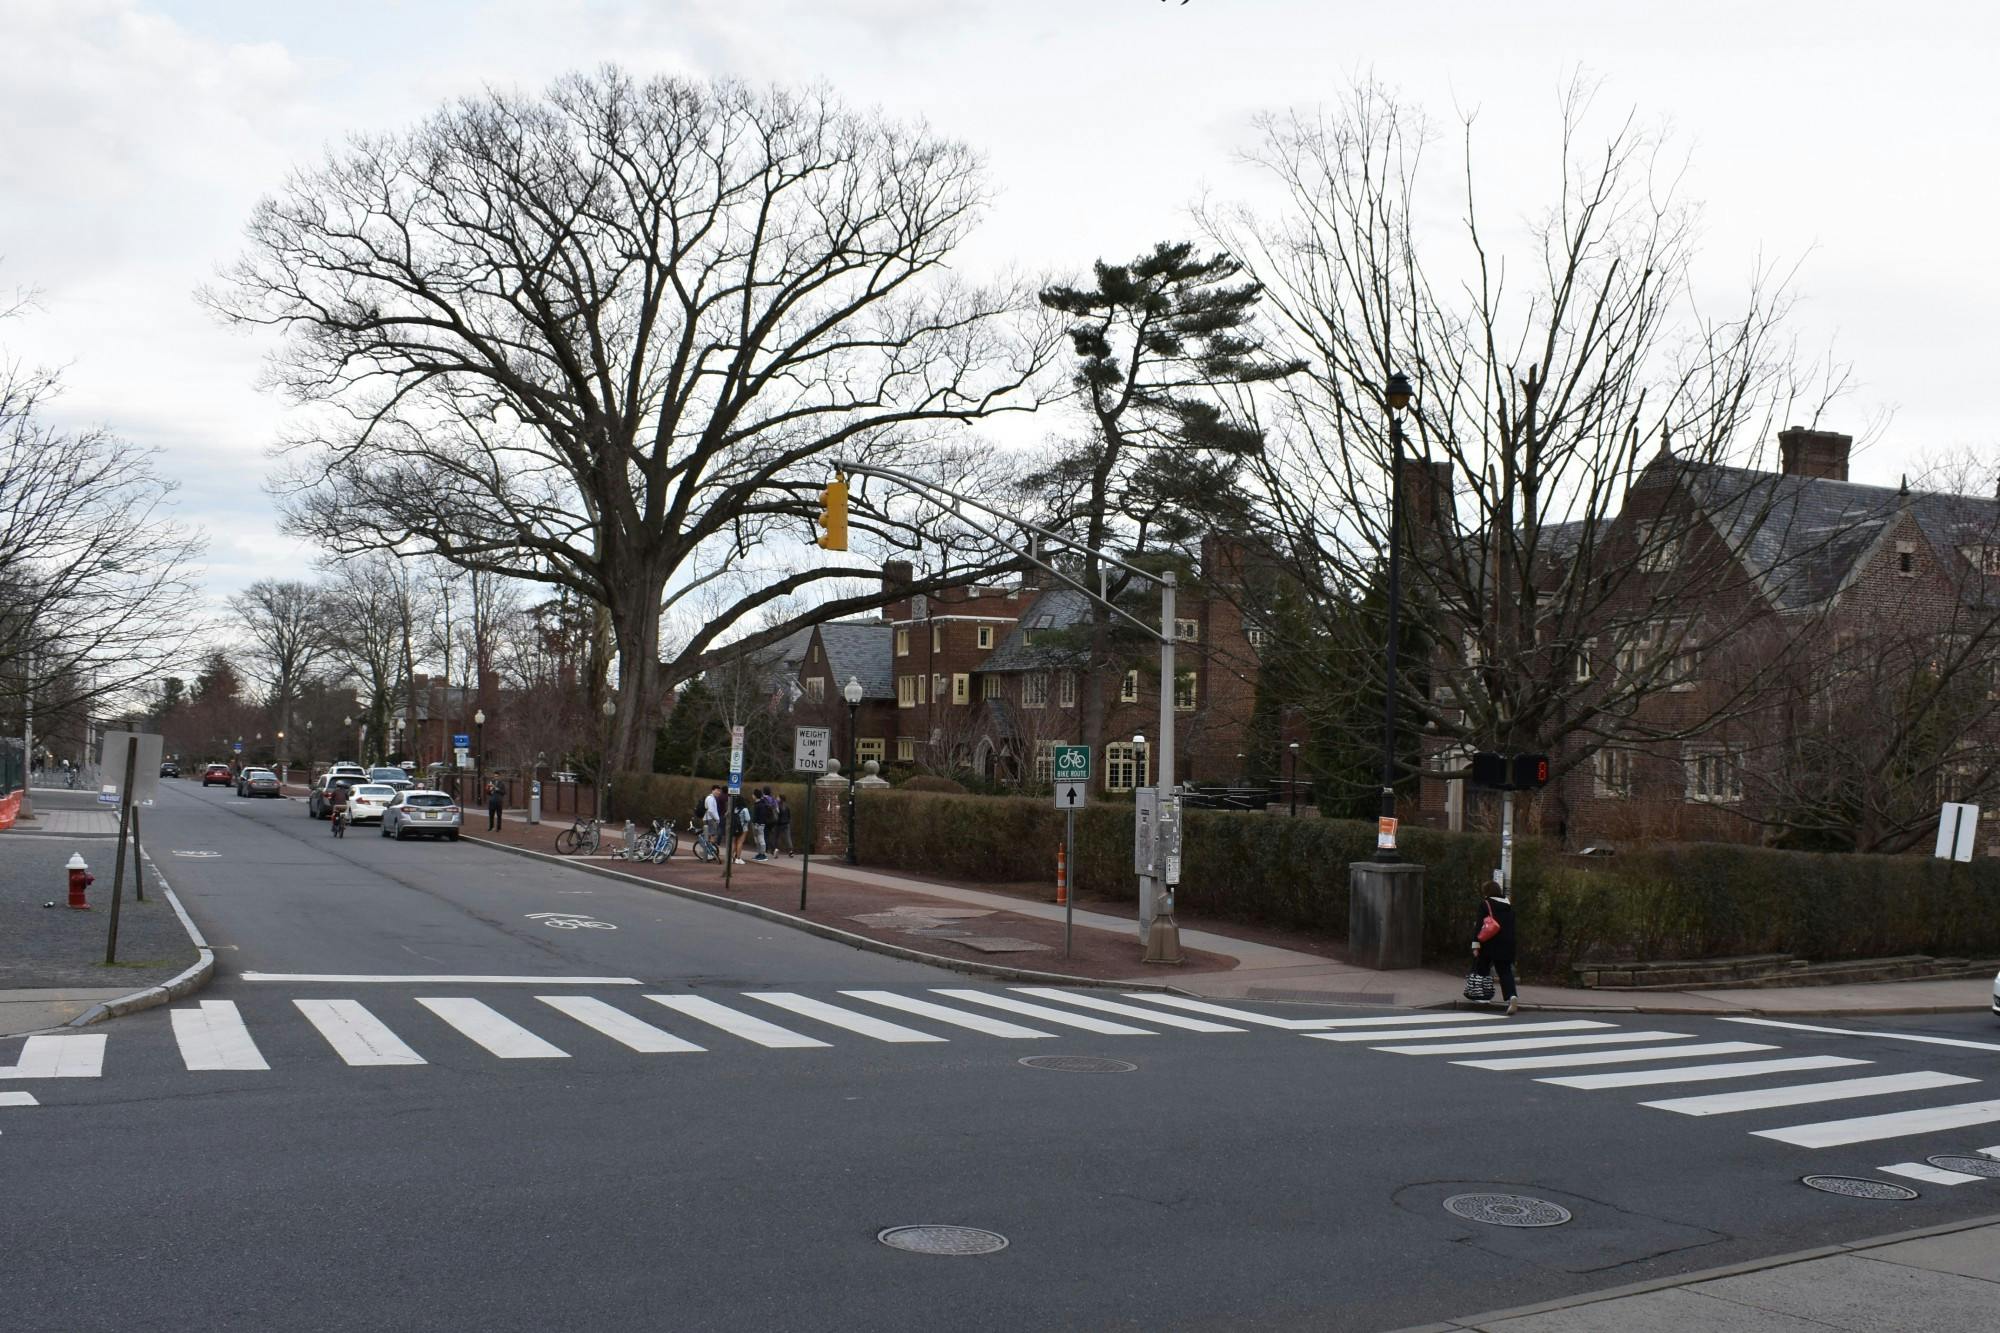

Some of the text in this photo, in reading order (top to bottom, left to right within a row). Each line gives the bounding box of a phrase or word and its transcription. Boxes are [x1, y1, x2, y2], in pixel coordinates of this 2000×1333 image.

[800, 730, 827, 738] WEIGHT
[808, 749, 815, 757] 4
[800, 759, 824, 768] TONS
